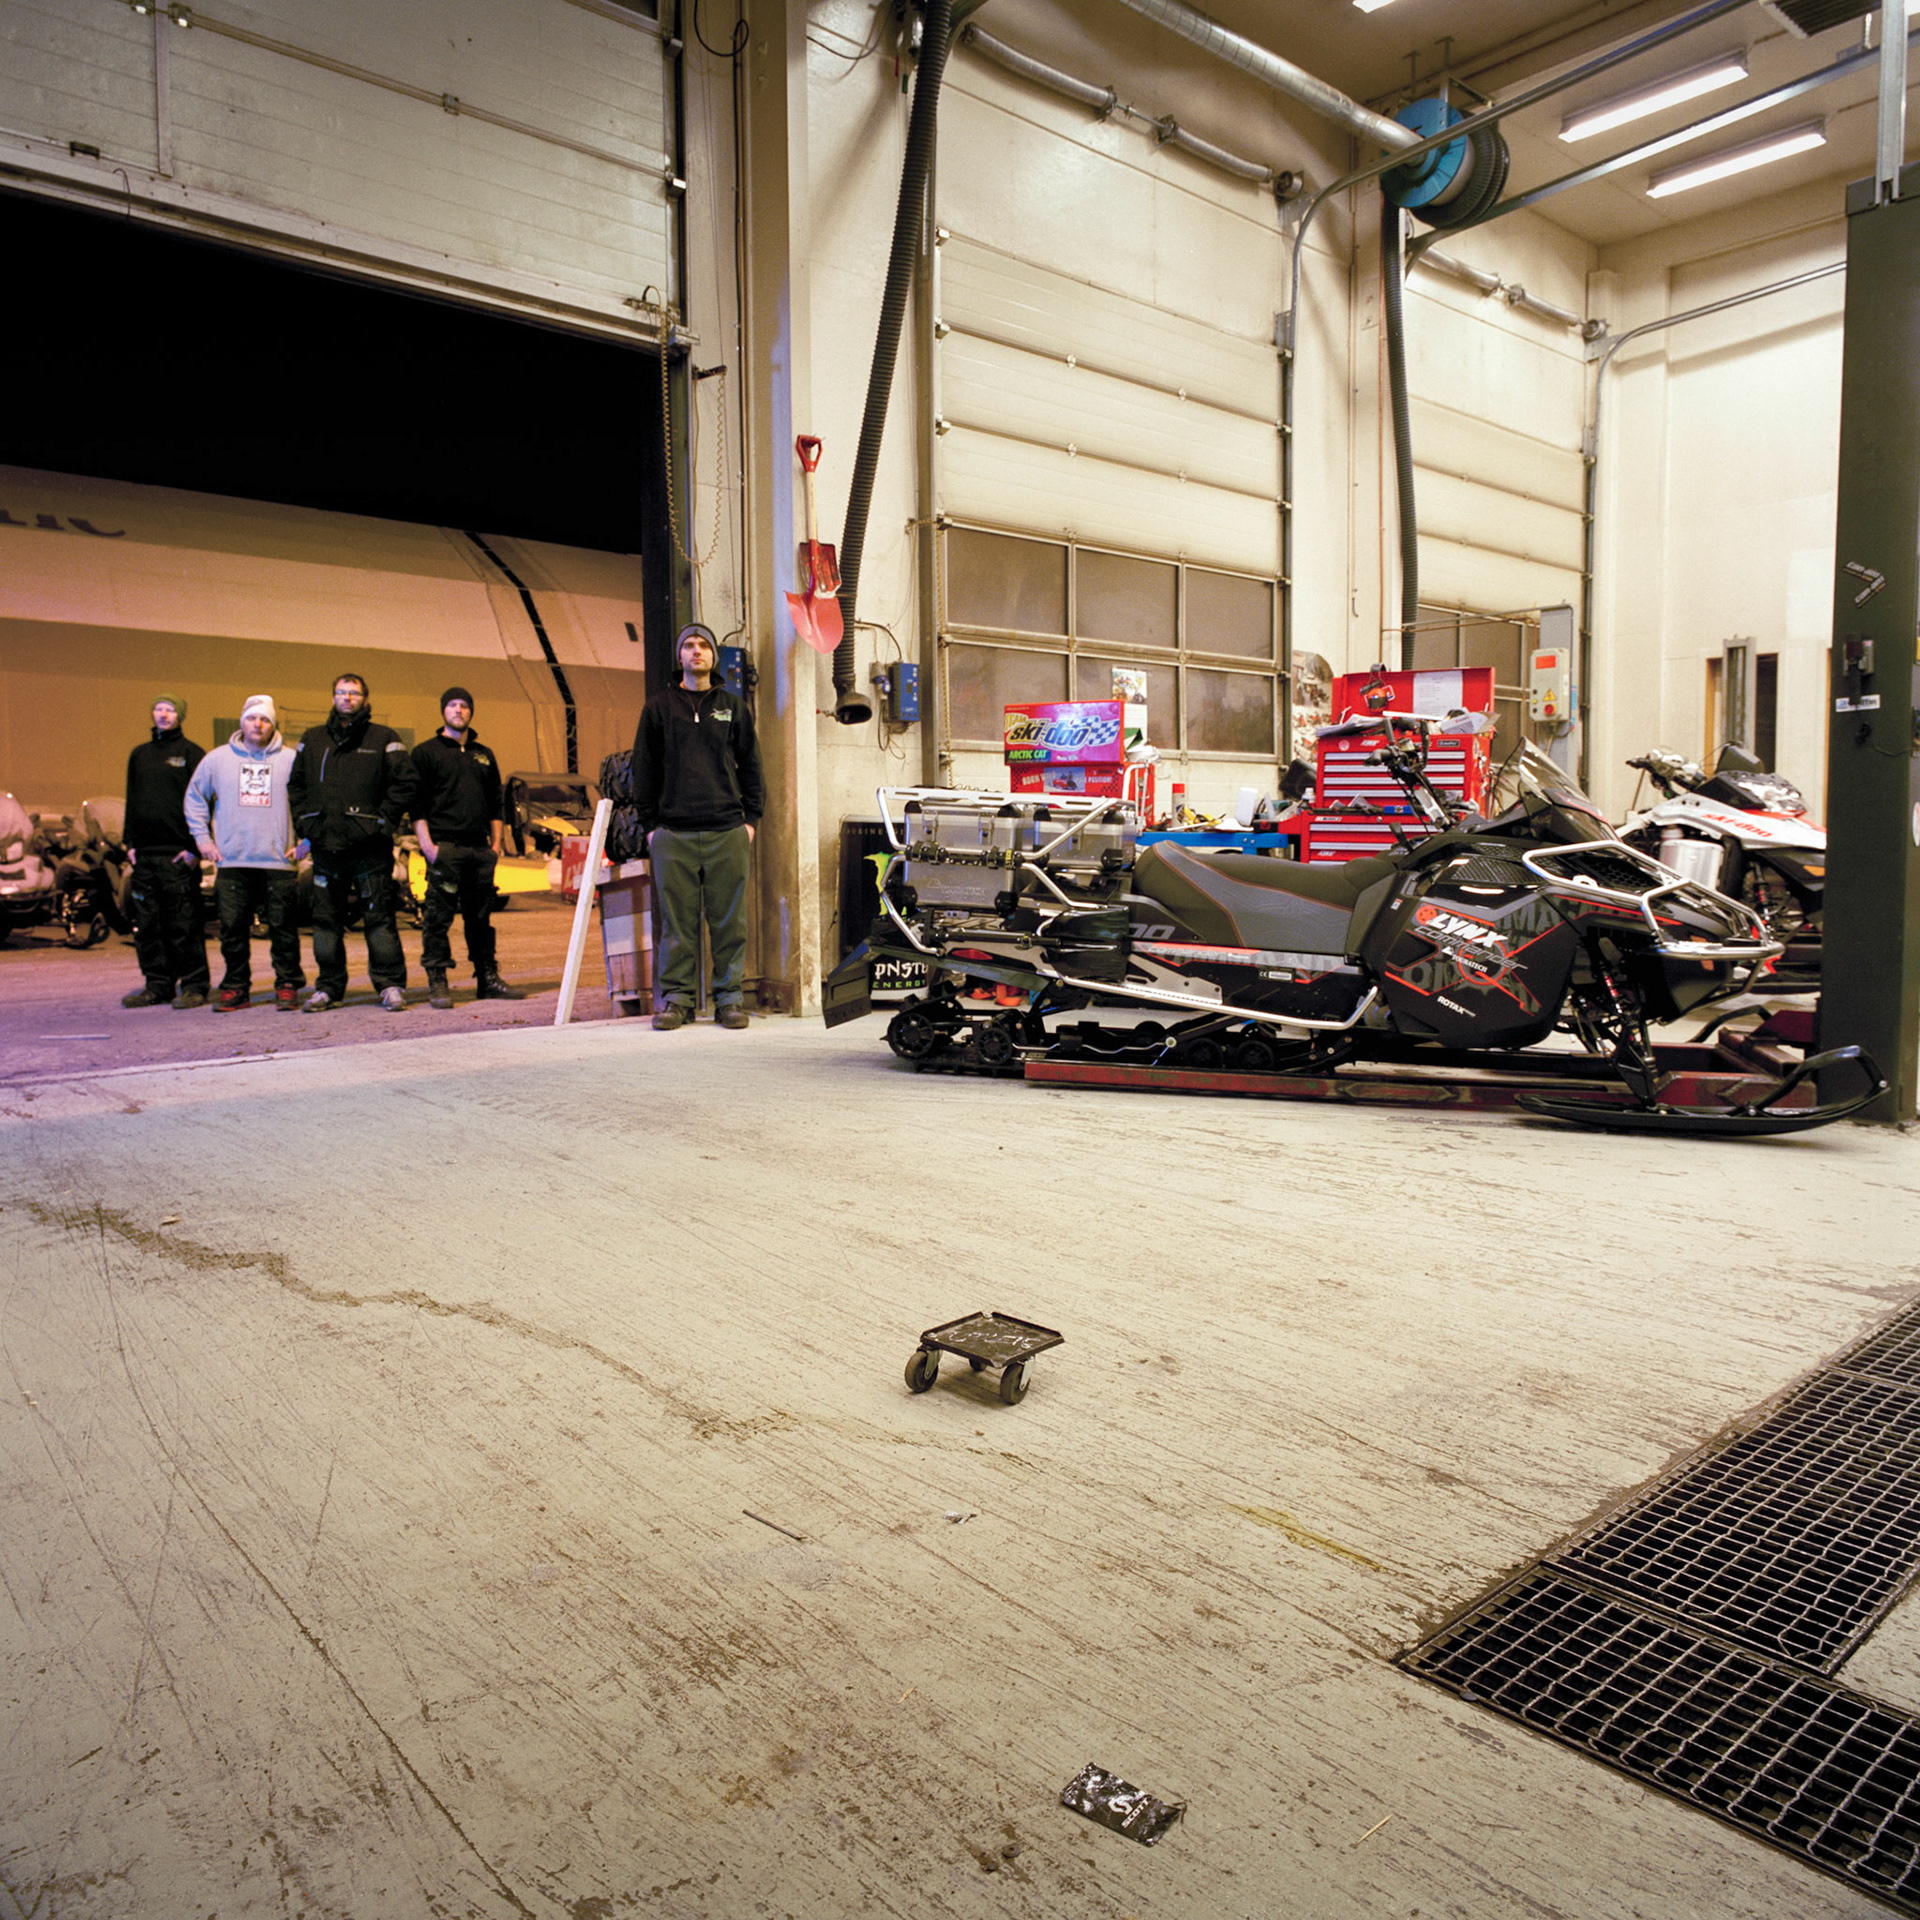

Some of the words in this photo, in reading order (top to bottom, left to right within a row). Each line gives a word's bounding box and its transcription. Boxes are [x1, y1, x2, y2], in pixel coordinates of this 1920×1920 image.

[1009, 721, 1090, 747] ski-doo
[1008, 750, 1033, 760] ARCTIC
[1033, 749, 1048, 759] CAT
[241, 795, 270, 805] OBEY
[1701, 813, 1773, 839] ski-doo
[1427, 913, 1509, 948] LYNX
[1413, 925, 1529, 971] commander
[1451, 954, 1489, 974] TOURATECH
[1436, 995, 1466, 1014] ROTAX
[1121, 1798, 1149, 1828] SCOTT
